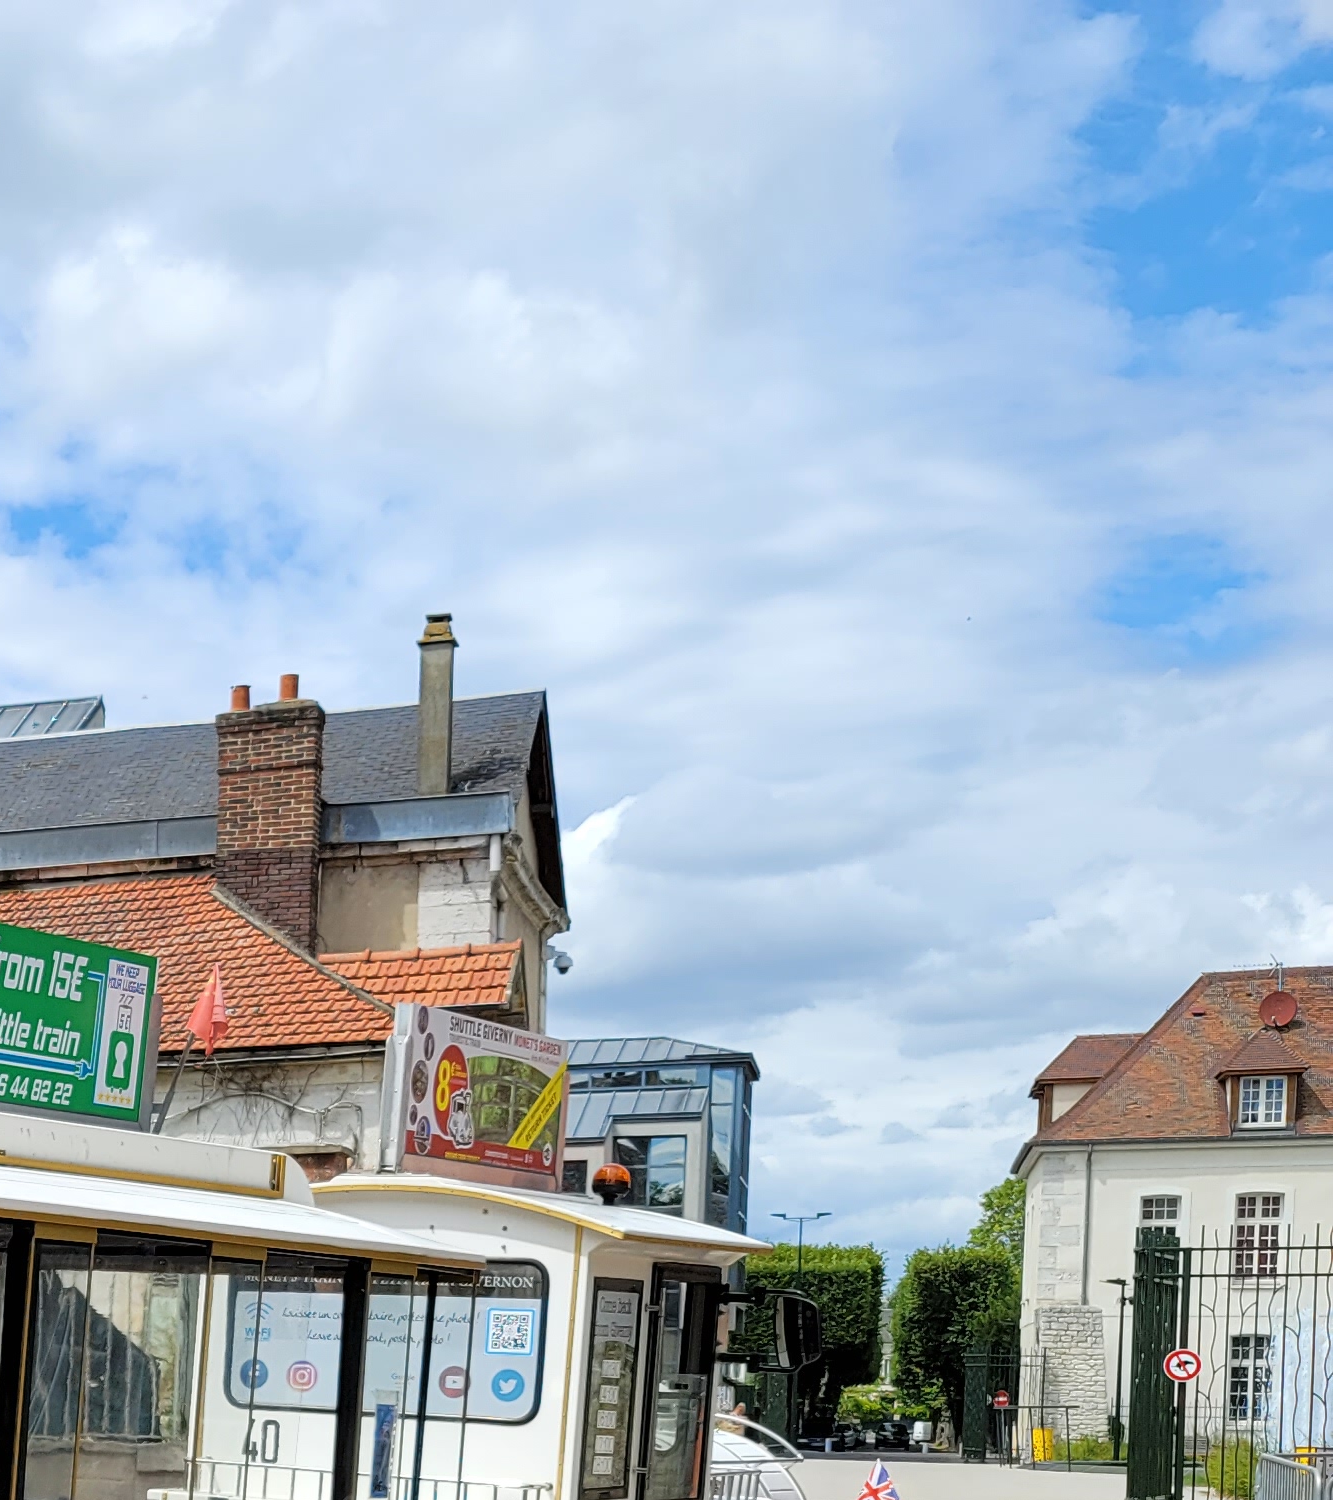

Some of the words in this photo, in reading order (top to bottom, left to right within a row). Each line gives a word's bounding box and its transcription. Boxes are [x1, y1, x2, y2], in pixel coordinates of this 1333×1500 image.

[48, 951, 89, 1001] 15€
[33, 1019, 80, 1056] train
[449, 1016, 482, 1037] SHUTTLE
[483, 1024, 514, 1044] GIVERNY
[9, 1076, 30, 1100] 44
[52, 1082, 73, 1105] 22
[241, 1419, 280, 1463] 40
